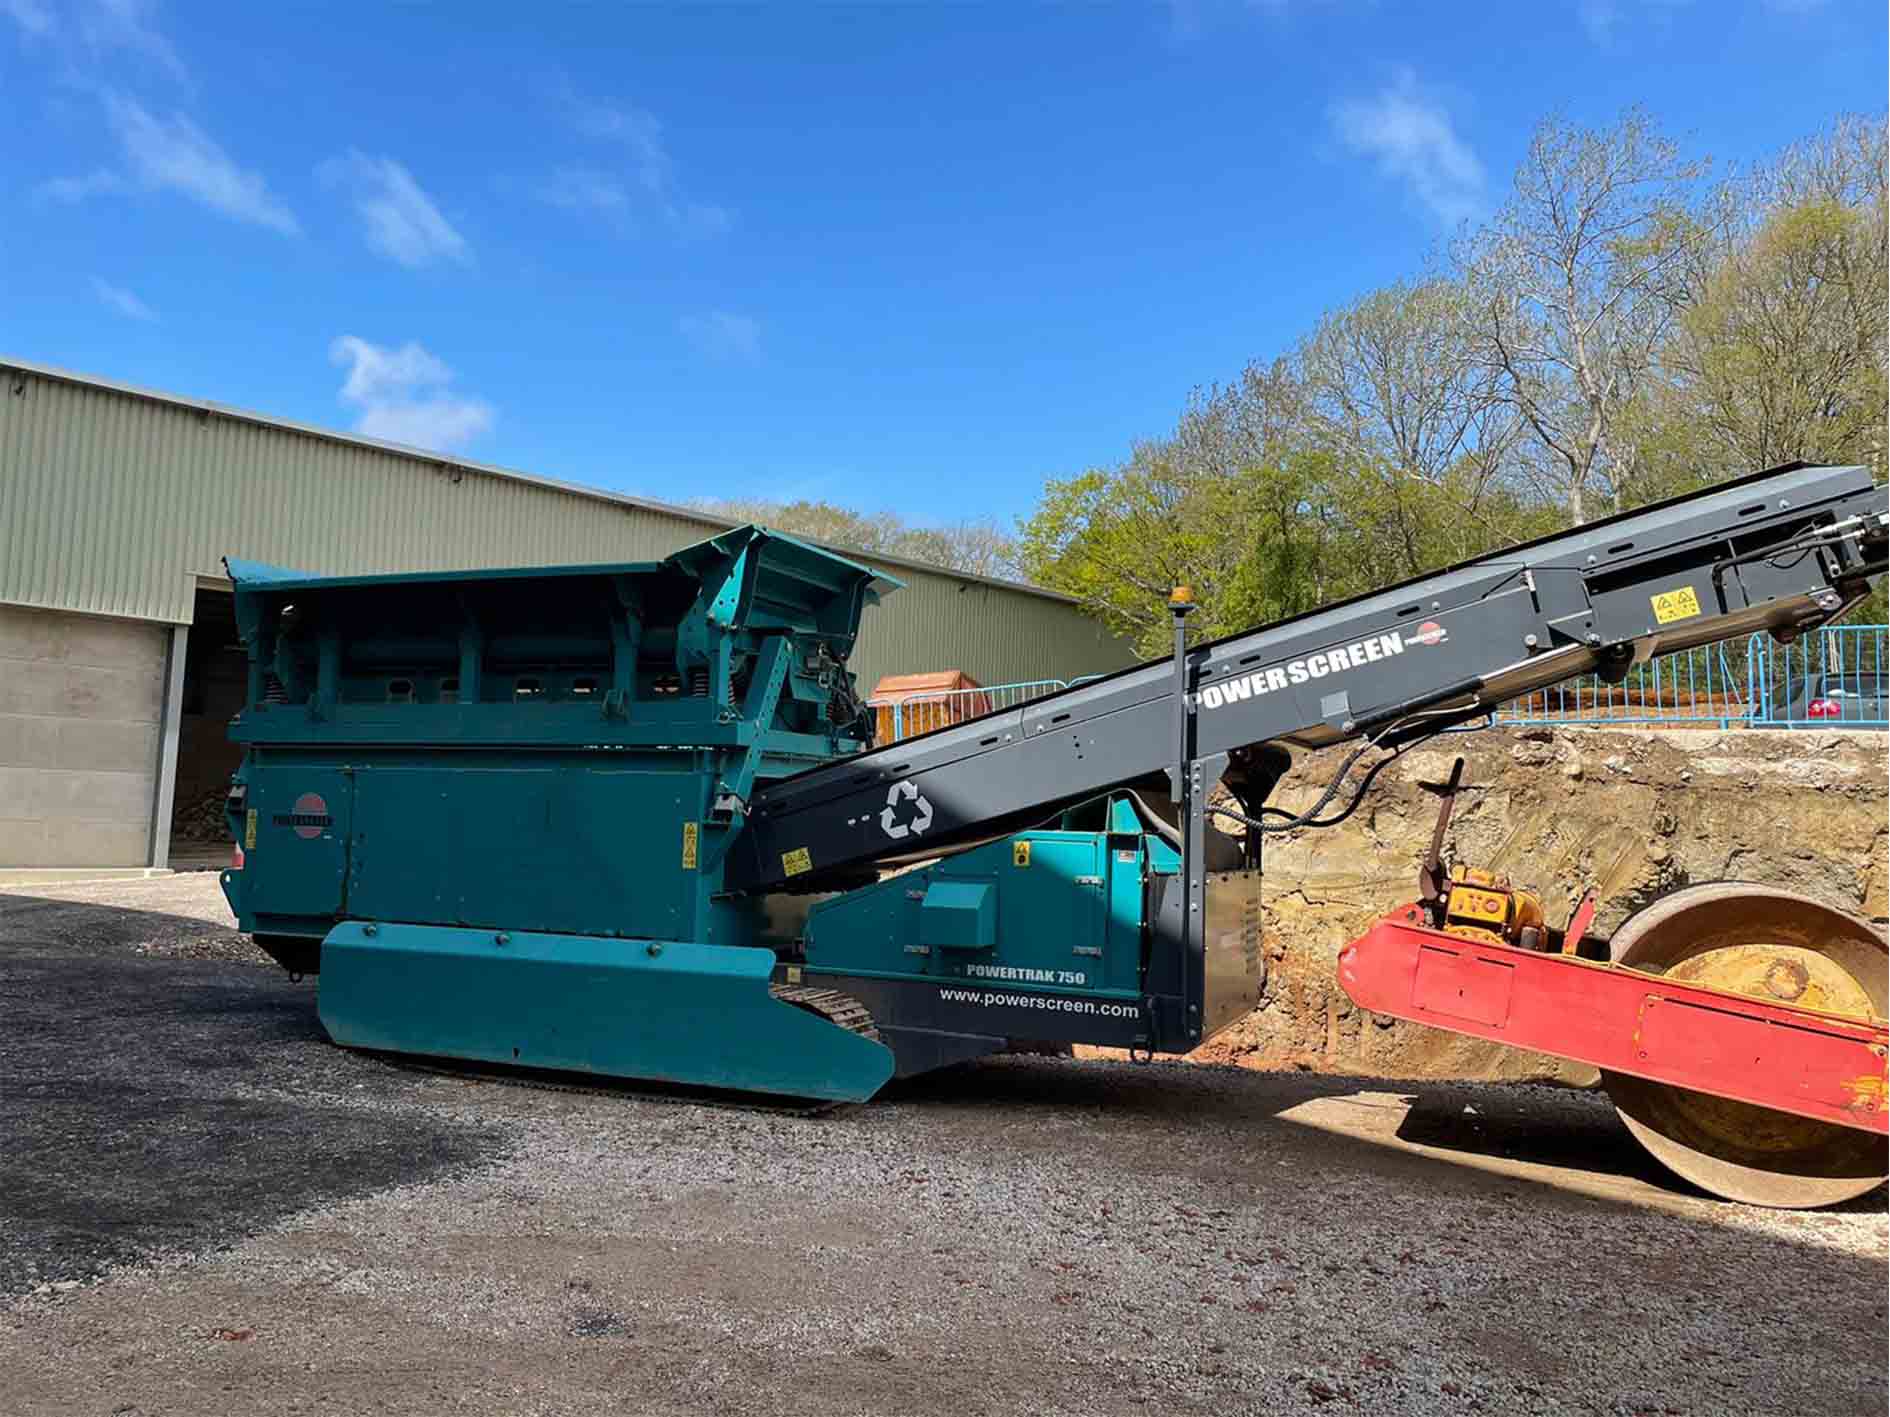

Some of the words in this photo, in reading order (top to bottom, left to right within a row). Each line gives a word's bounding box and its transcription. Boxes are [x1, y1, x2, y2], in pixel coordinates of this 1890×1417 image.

[1184, 632, 1404, 710] POWERSCREEN
[967, 964, 1055, 983] POWERTRAK
[1056, 971, 1086, 985] 750
[939, 988, 1139, 1018] www.powerscreen.com
